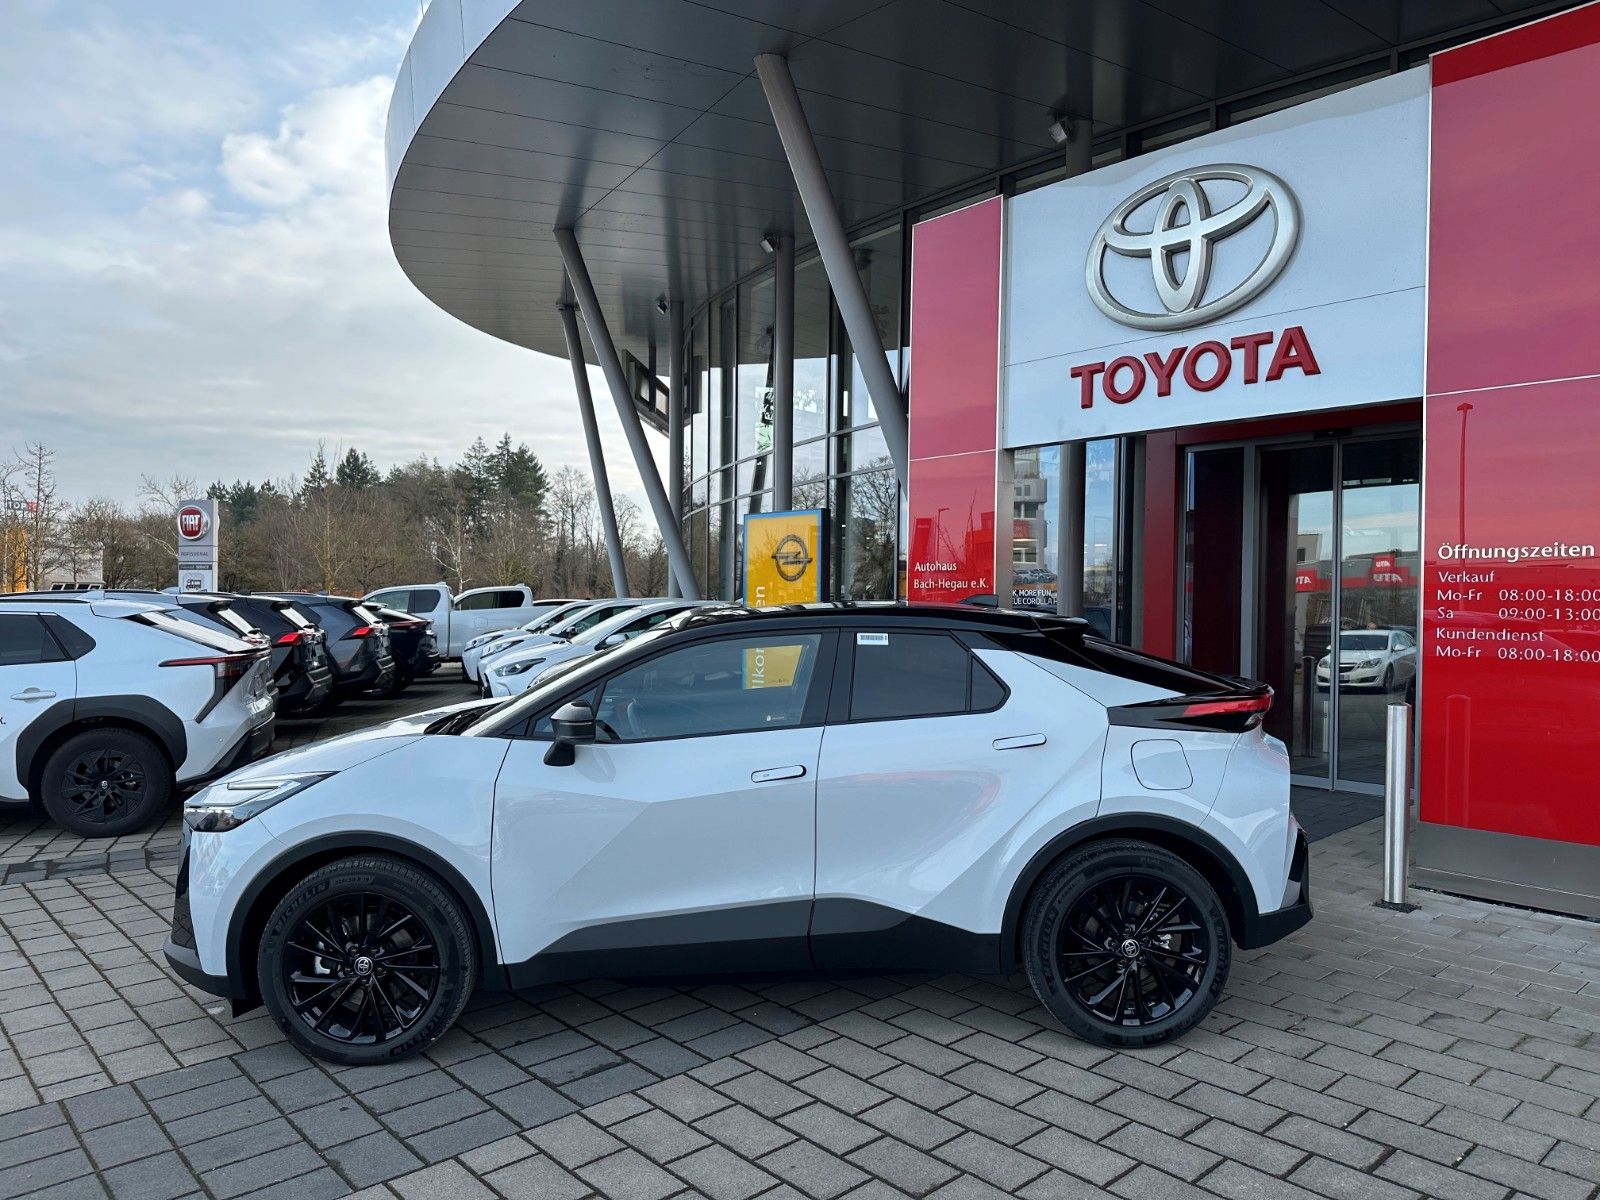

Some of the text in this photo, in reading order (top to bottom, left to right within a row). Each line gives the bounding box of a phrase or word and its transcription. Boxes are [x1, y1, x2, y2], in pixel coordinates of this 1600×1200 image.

[1070, 325, 1321, 409] TOYOTA
[182, 514, 200, 531] FIAT
[1438, 541, 1595, 563] Öffnungszeiten
[914, 561, 957, 572] Autohaus
[1438, 570, 1496, 583] Verkauf
[913, 577, 989, 592] Bach-Hegau e.K.
[1019, 589, 1037, 597] MORE
[1437, 588, 1600, 601] Mo-Fr 08:00-18:00
[1437, 606, 1600, 621] Sa 09:00-13:00
[1436, 627, 1544, 642] Kundendienst
[1436, 645, 1600, 663] Mo-Fr 08:00-18:00
